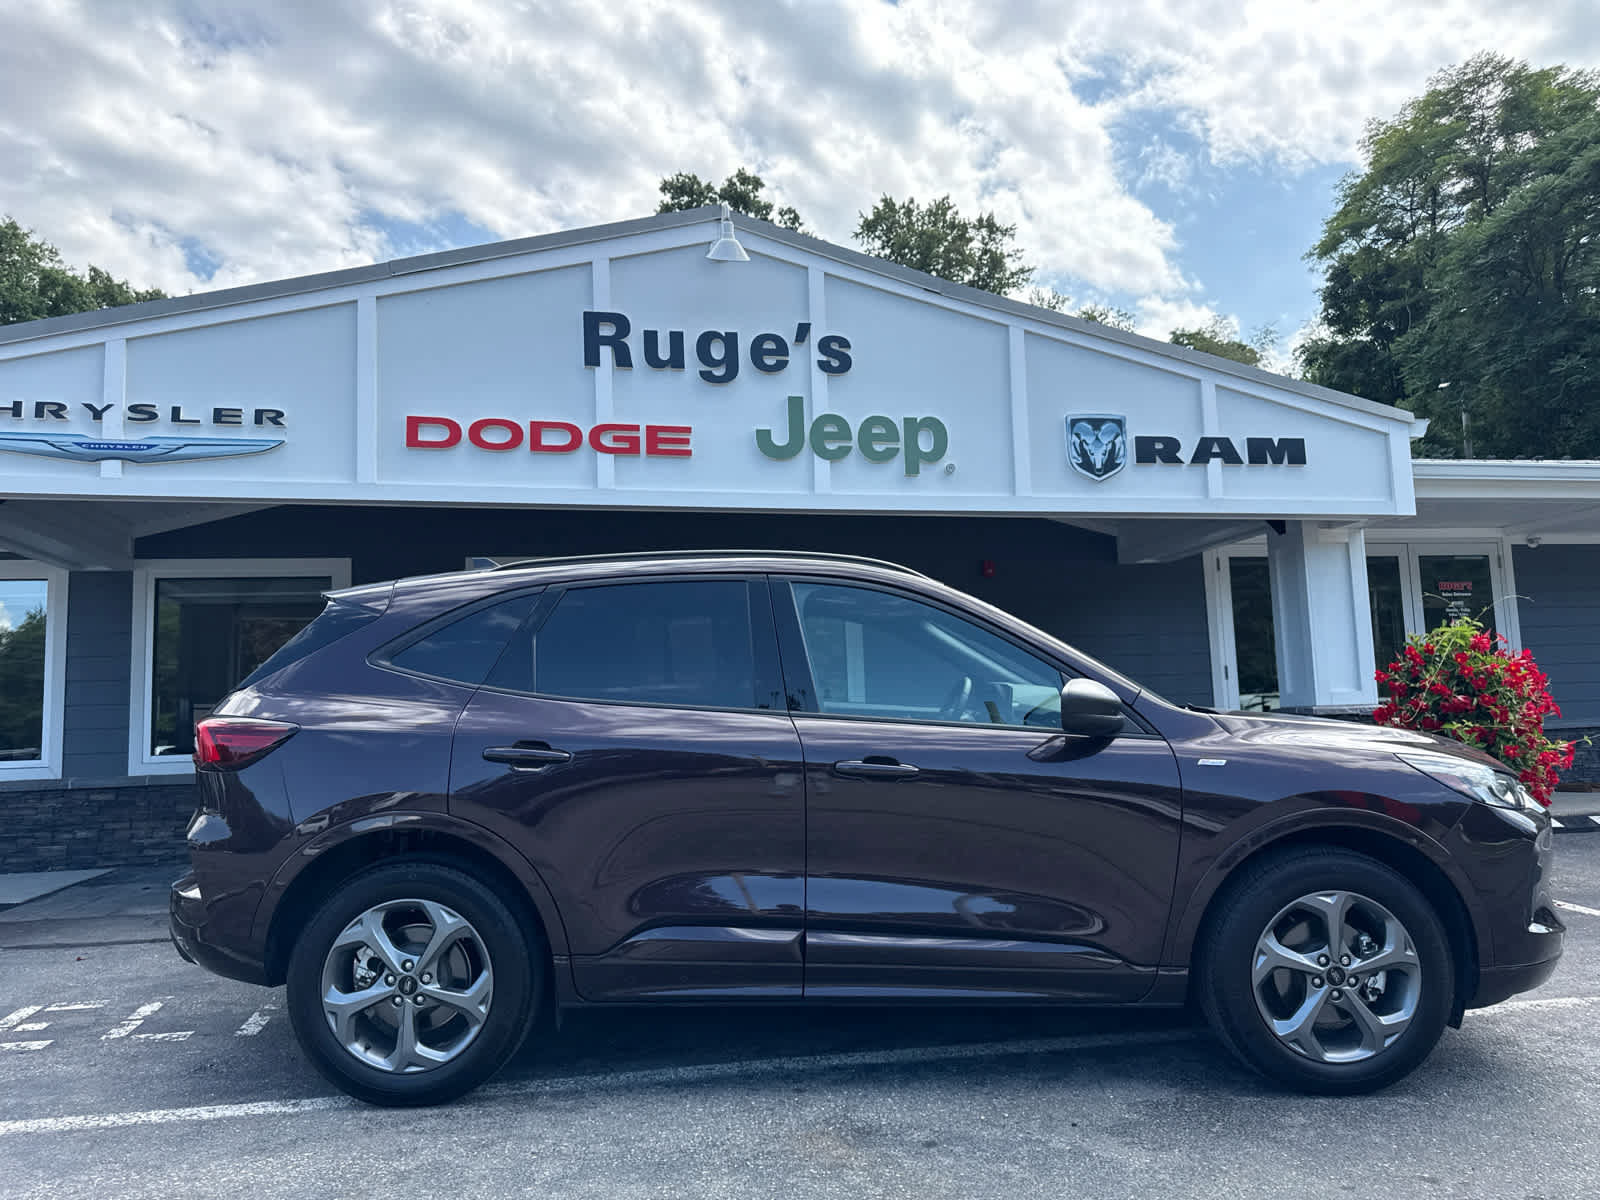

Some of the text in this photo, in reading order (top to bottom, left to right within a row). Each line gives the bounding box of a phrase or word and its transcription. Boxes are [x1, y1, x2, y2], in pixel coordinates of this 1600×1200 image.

[583, 311, 853, 385] Ruge's
[0, 400, 286, 426] HRYSLER
[406, 415, 692, 456] DODGE
[755, 396, 949, 477] Jeep
[1134, 435, 1307, 465] RAM
